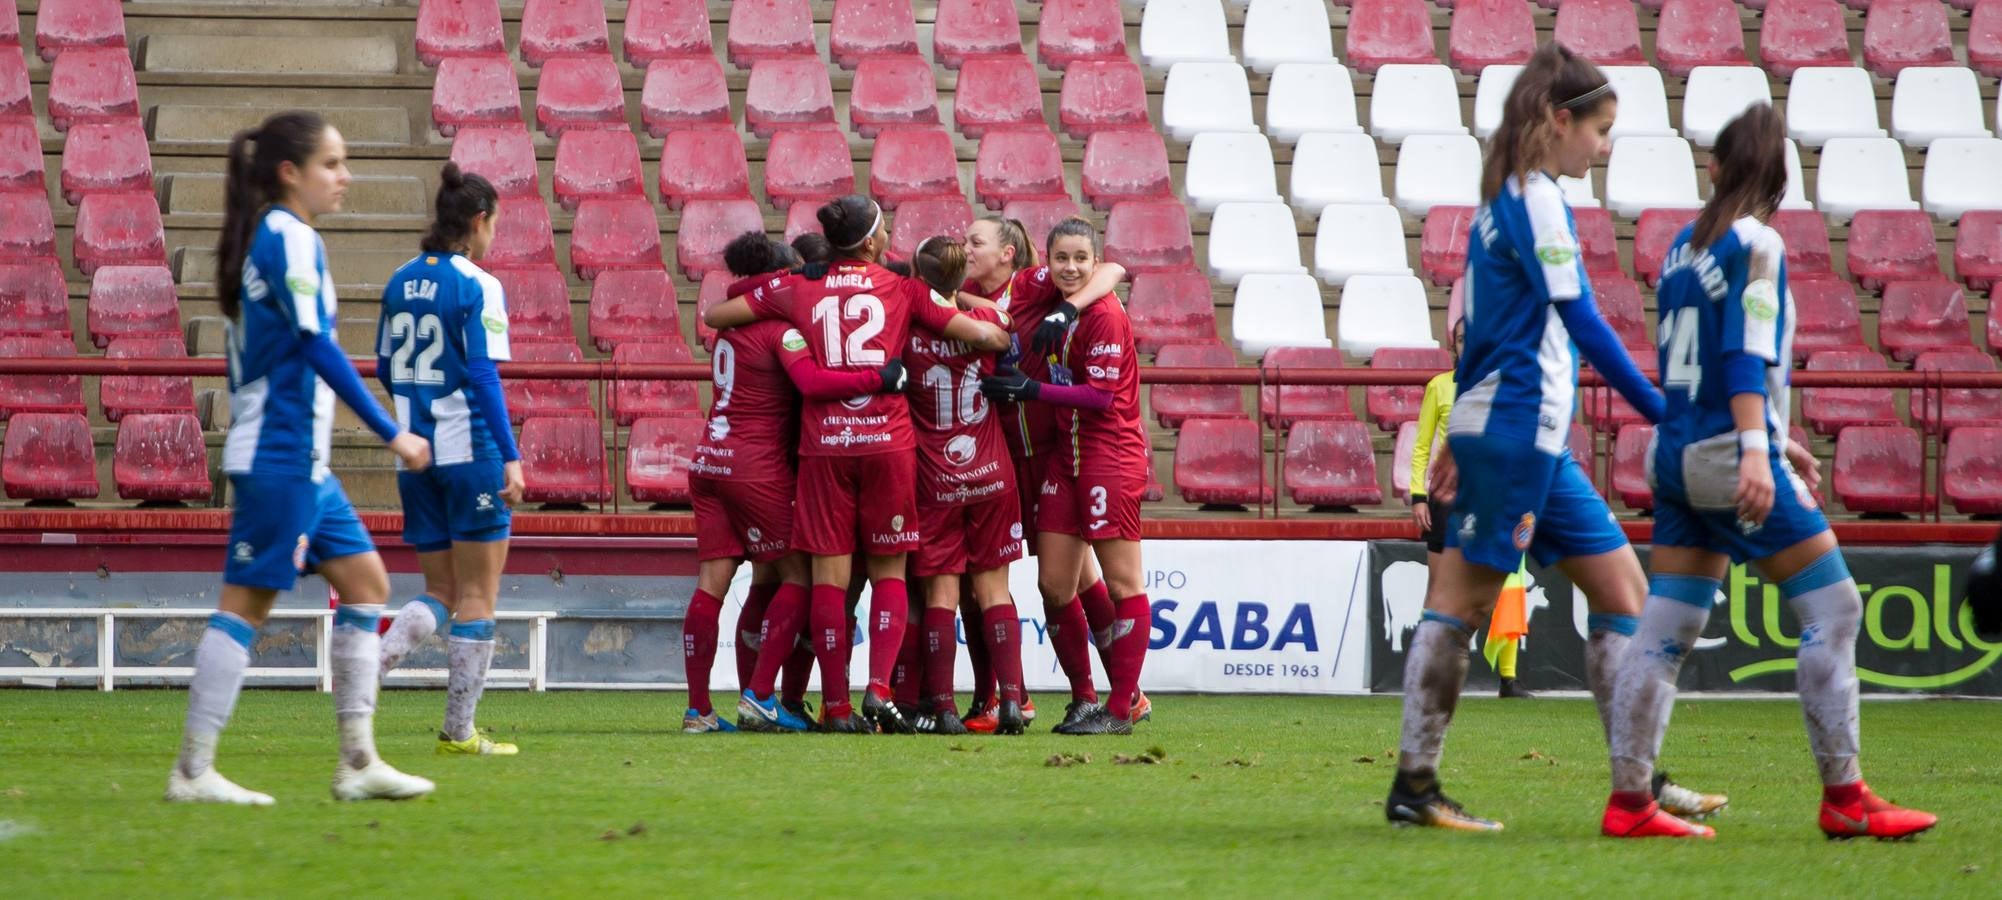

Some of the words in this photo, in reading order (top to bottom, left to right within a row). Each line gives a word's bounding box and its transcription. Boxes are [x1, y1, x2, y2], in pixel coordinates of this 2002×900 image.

[403, 279, 438, 301] ELBA
[825, 274, 874, 289] NAGELA
[390, 312, 445, 384] 22
[812, 294, 885, 367] 12
[713, 338, 735, 410] 9
[923, 359, 989, 430] 16
[1090, 486, 1107, 516] 3
[1146, 599, 1320, 652] SABA
[1224, 663, 1275, 676] DESDE
[1281, 664, 1320, 677] 1963
